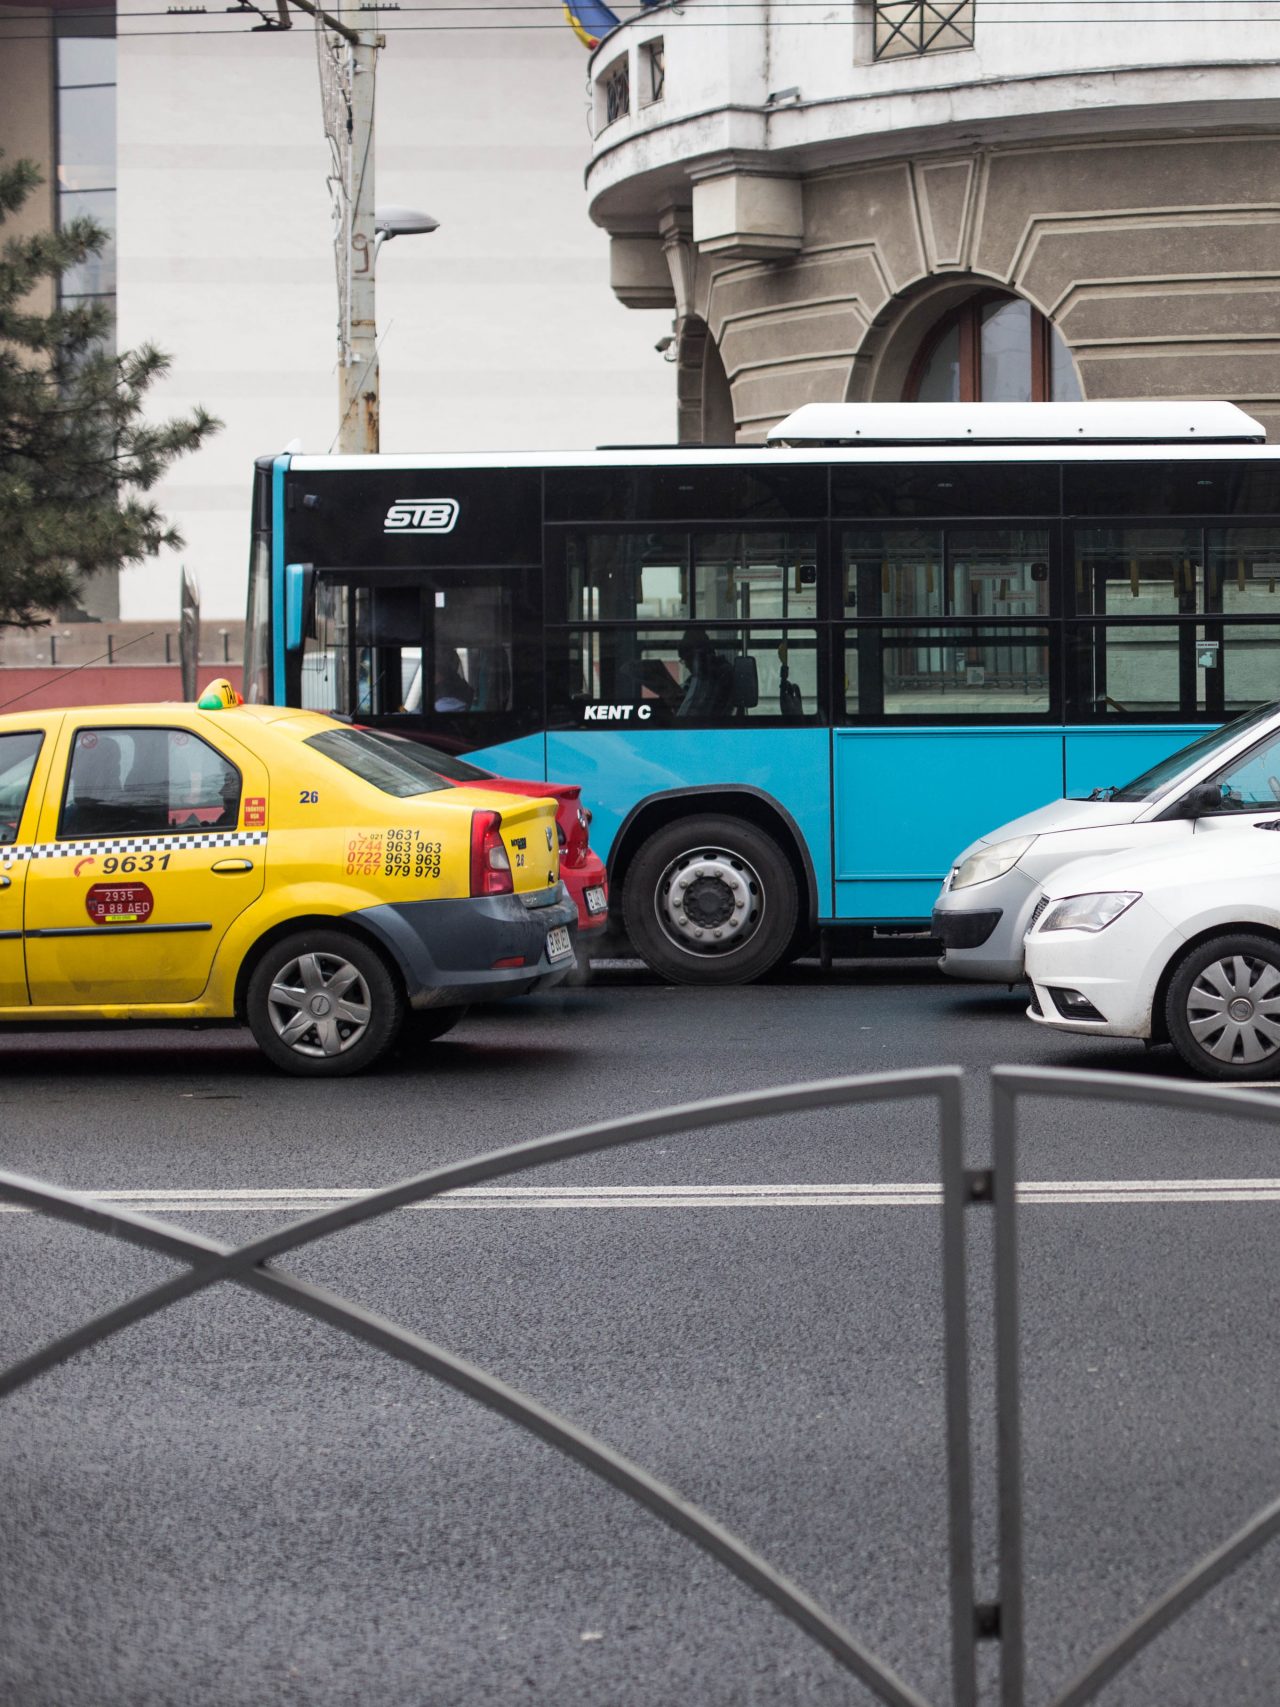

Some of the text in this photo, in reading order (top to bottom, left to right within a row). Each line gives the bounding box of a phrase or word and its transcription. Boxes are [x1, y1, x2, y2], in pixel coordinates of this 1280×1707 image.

[384, 503, 454, 528] STB
[584, 704, 652, 720] KENT C
[299, 790, 319, 804] 26
[386, 829, 420, 841] 9631
[348, 840, 442, 854] 0744 963 963
[102, 853, 171, 875] 9631
[347, 852, 441, 866] 0722 963 963
[346, 863, 441, 878] 0767 979 979
[104, 891, 134, 902] 2935
[97, 902, 150, 914] B 88 AED
